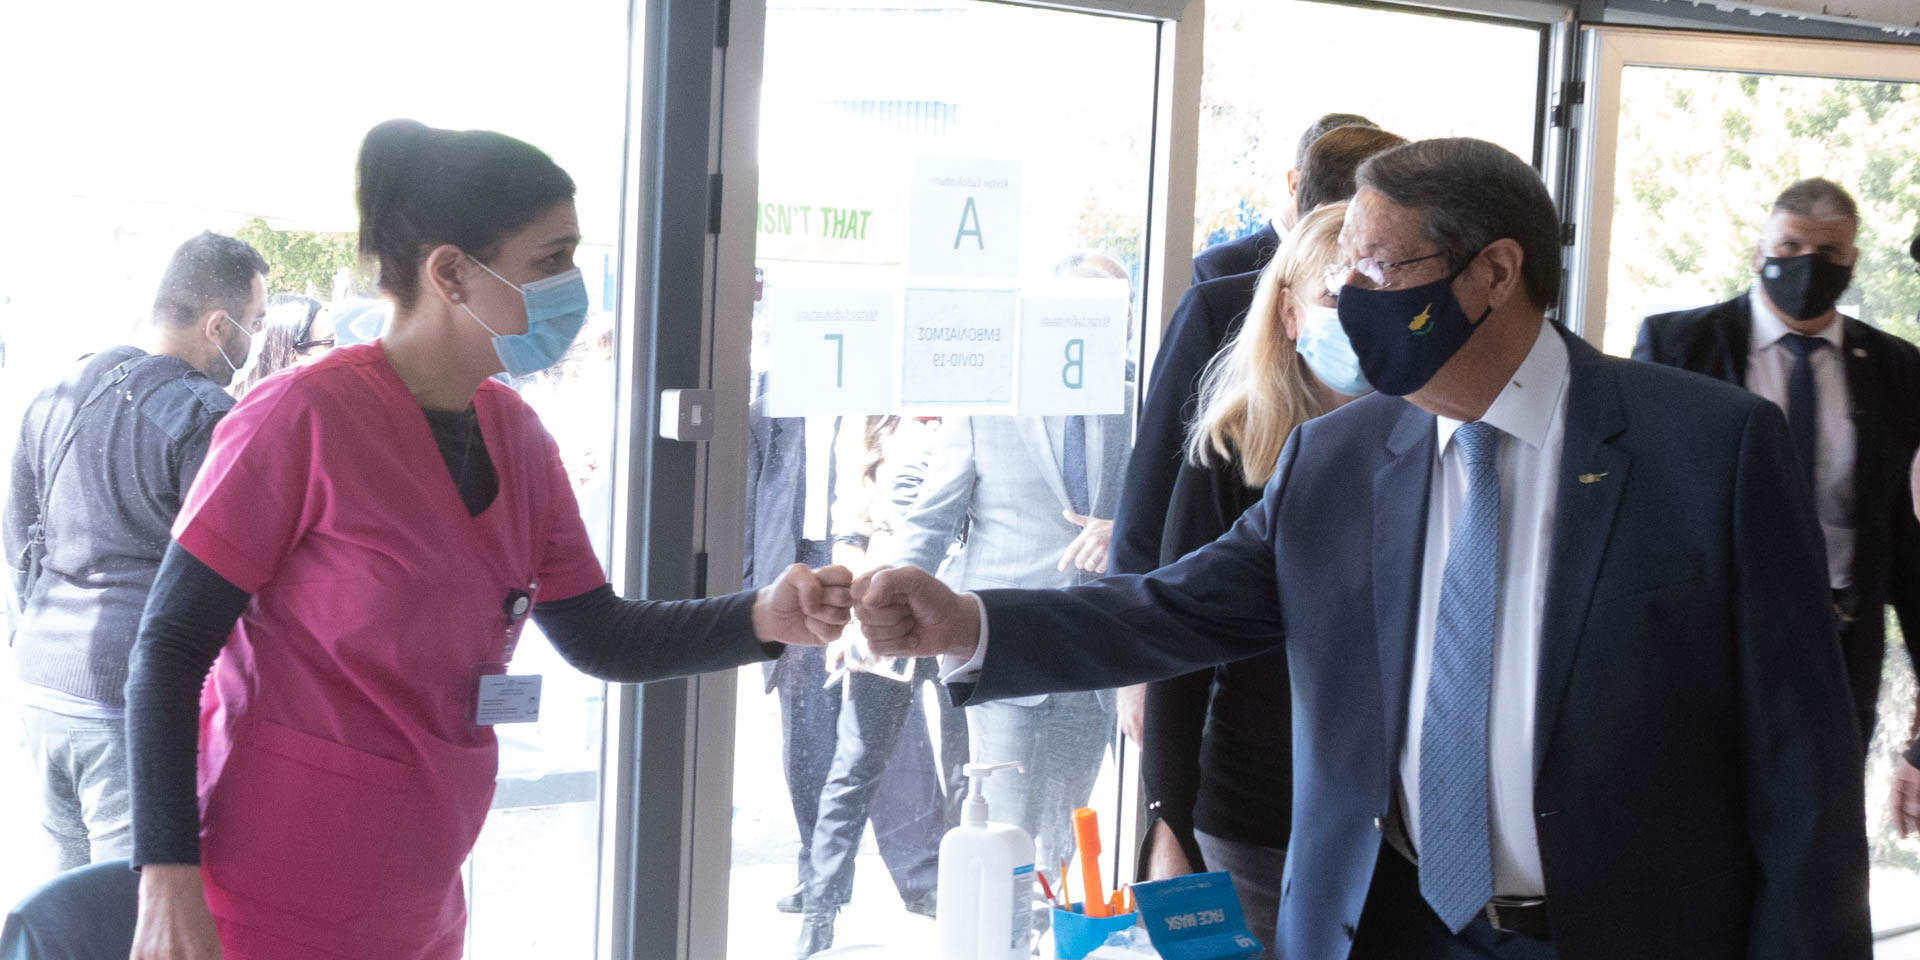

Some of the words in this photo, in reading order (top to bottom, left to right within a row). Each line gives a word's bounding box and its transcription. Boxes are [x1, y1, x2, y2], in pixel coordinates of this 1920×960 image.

[757, 203, 812, 235] ISN'T
[819, 207, 872, 240] THAT
[1164, 912, 1198, 931] MASK
[1196, 908, 1225, 926] FACE
